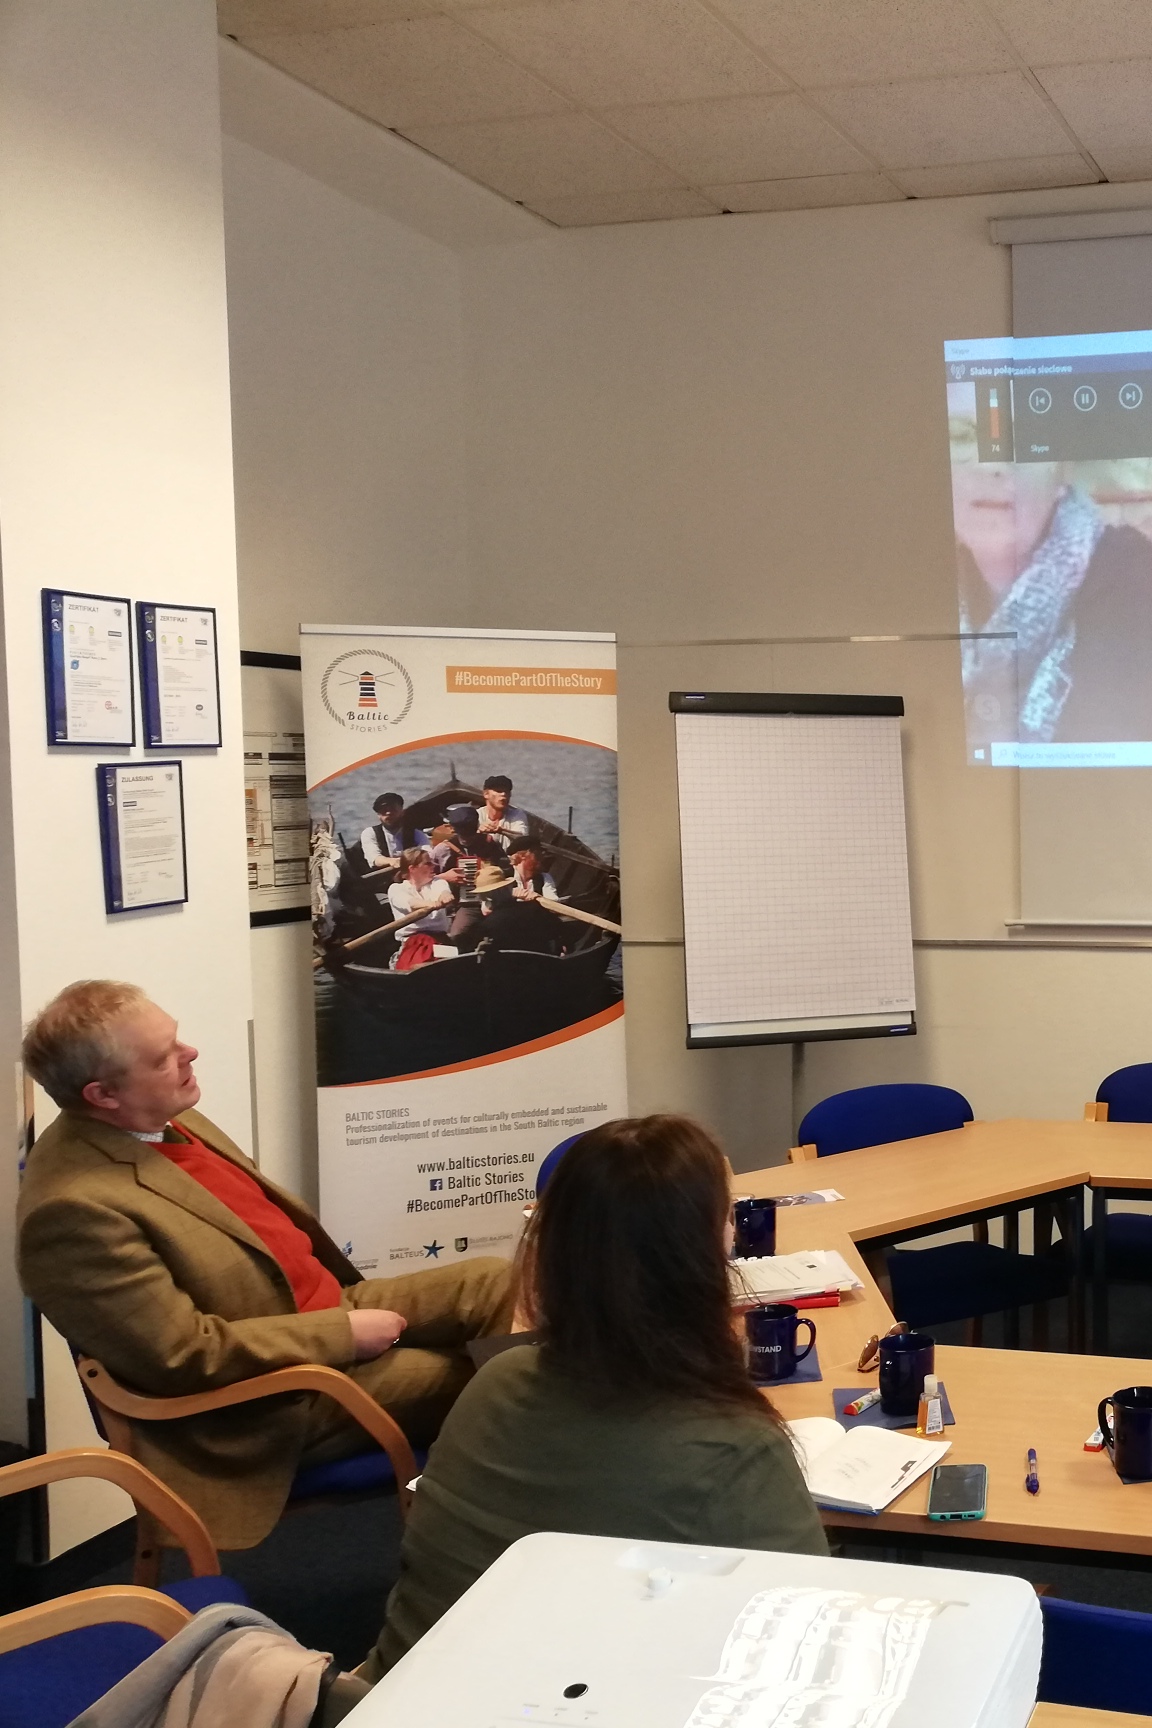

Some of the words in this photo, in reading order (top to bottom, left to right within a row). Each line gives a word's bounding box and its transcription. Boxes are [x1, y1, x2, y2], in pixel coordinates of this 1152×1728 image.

[68, 604, 99, 613] ZERTIFIKAT
[160, 615, 188, 624] ZERTIFIKAT
[455, 671, 602, 689] #BecomePartOfTheStory
[346, 711, 389, 721] Baltic
[350, 723, 388, 733] STORIES
[121, 775, 154, 783] ZULASSUNG
[345, 1111, 374, 1122] BALTIC
[376, 1107, 410, 1120] STORIES
[345, 1120, 421, 1134] Professionalization
[422, 1118, 431, 1127] of
[432, 1116, 458, 1126] events
[460, 1114, 471, 1124] for
[473, 1111, 509, 1123] culturally
[511, 1107, 549, 1119] embedded
[551, 1106, 565, 1115] and
[567, 1102, 608, 1114] sustainable
[346, 1136, 377, 1147] tourism
[379, 1130, 429, 1143] development
[431, 1129, 440, 1138] of
[441, 1126, 488, 1137] destinations
[490, 1124, 497, 1132] in
[499, 1122, 512, 1132] the
[514, 1119, 536, 1131] South
[537, 1118, 560, 1128] Baltic
[561, 1116, 585, 1127] region
[417, 1153, 535, 1174] www.balticstories.eu
[448, 1175, 481, 1190] Baltic
[484, 1171, 525, 1186] Stories
[406, 1188, 536, 1213] #BecomePartOfTheSto
[389, 1250, 425, 1261] BALTEUS
